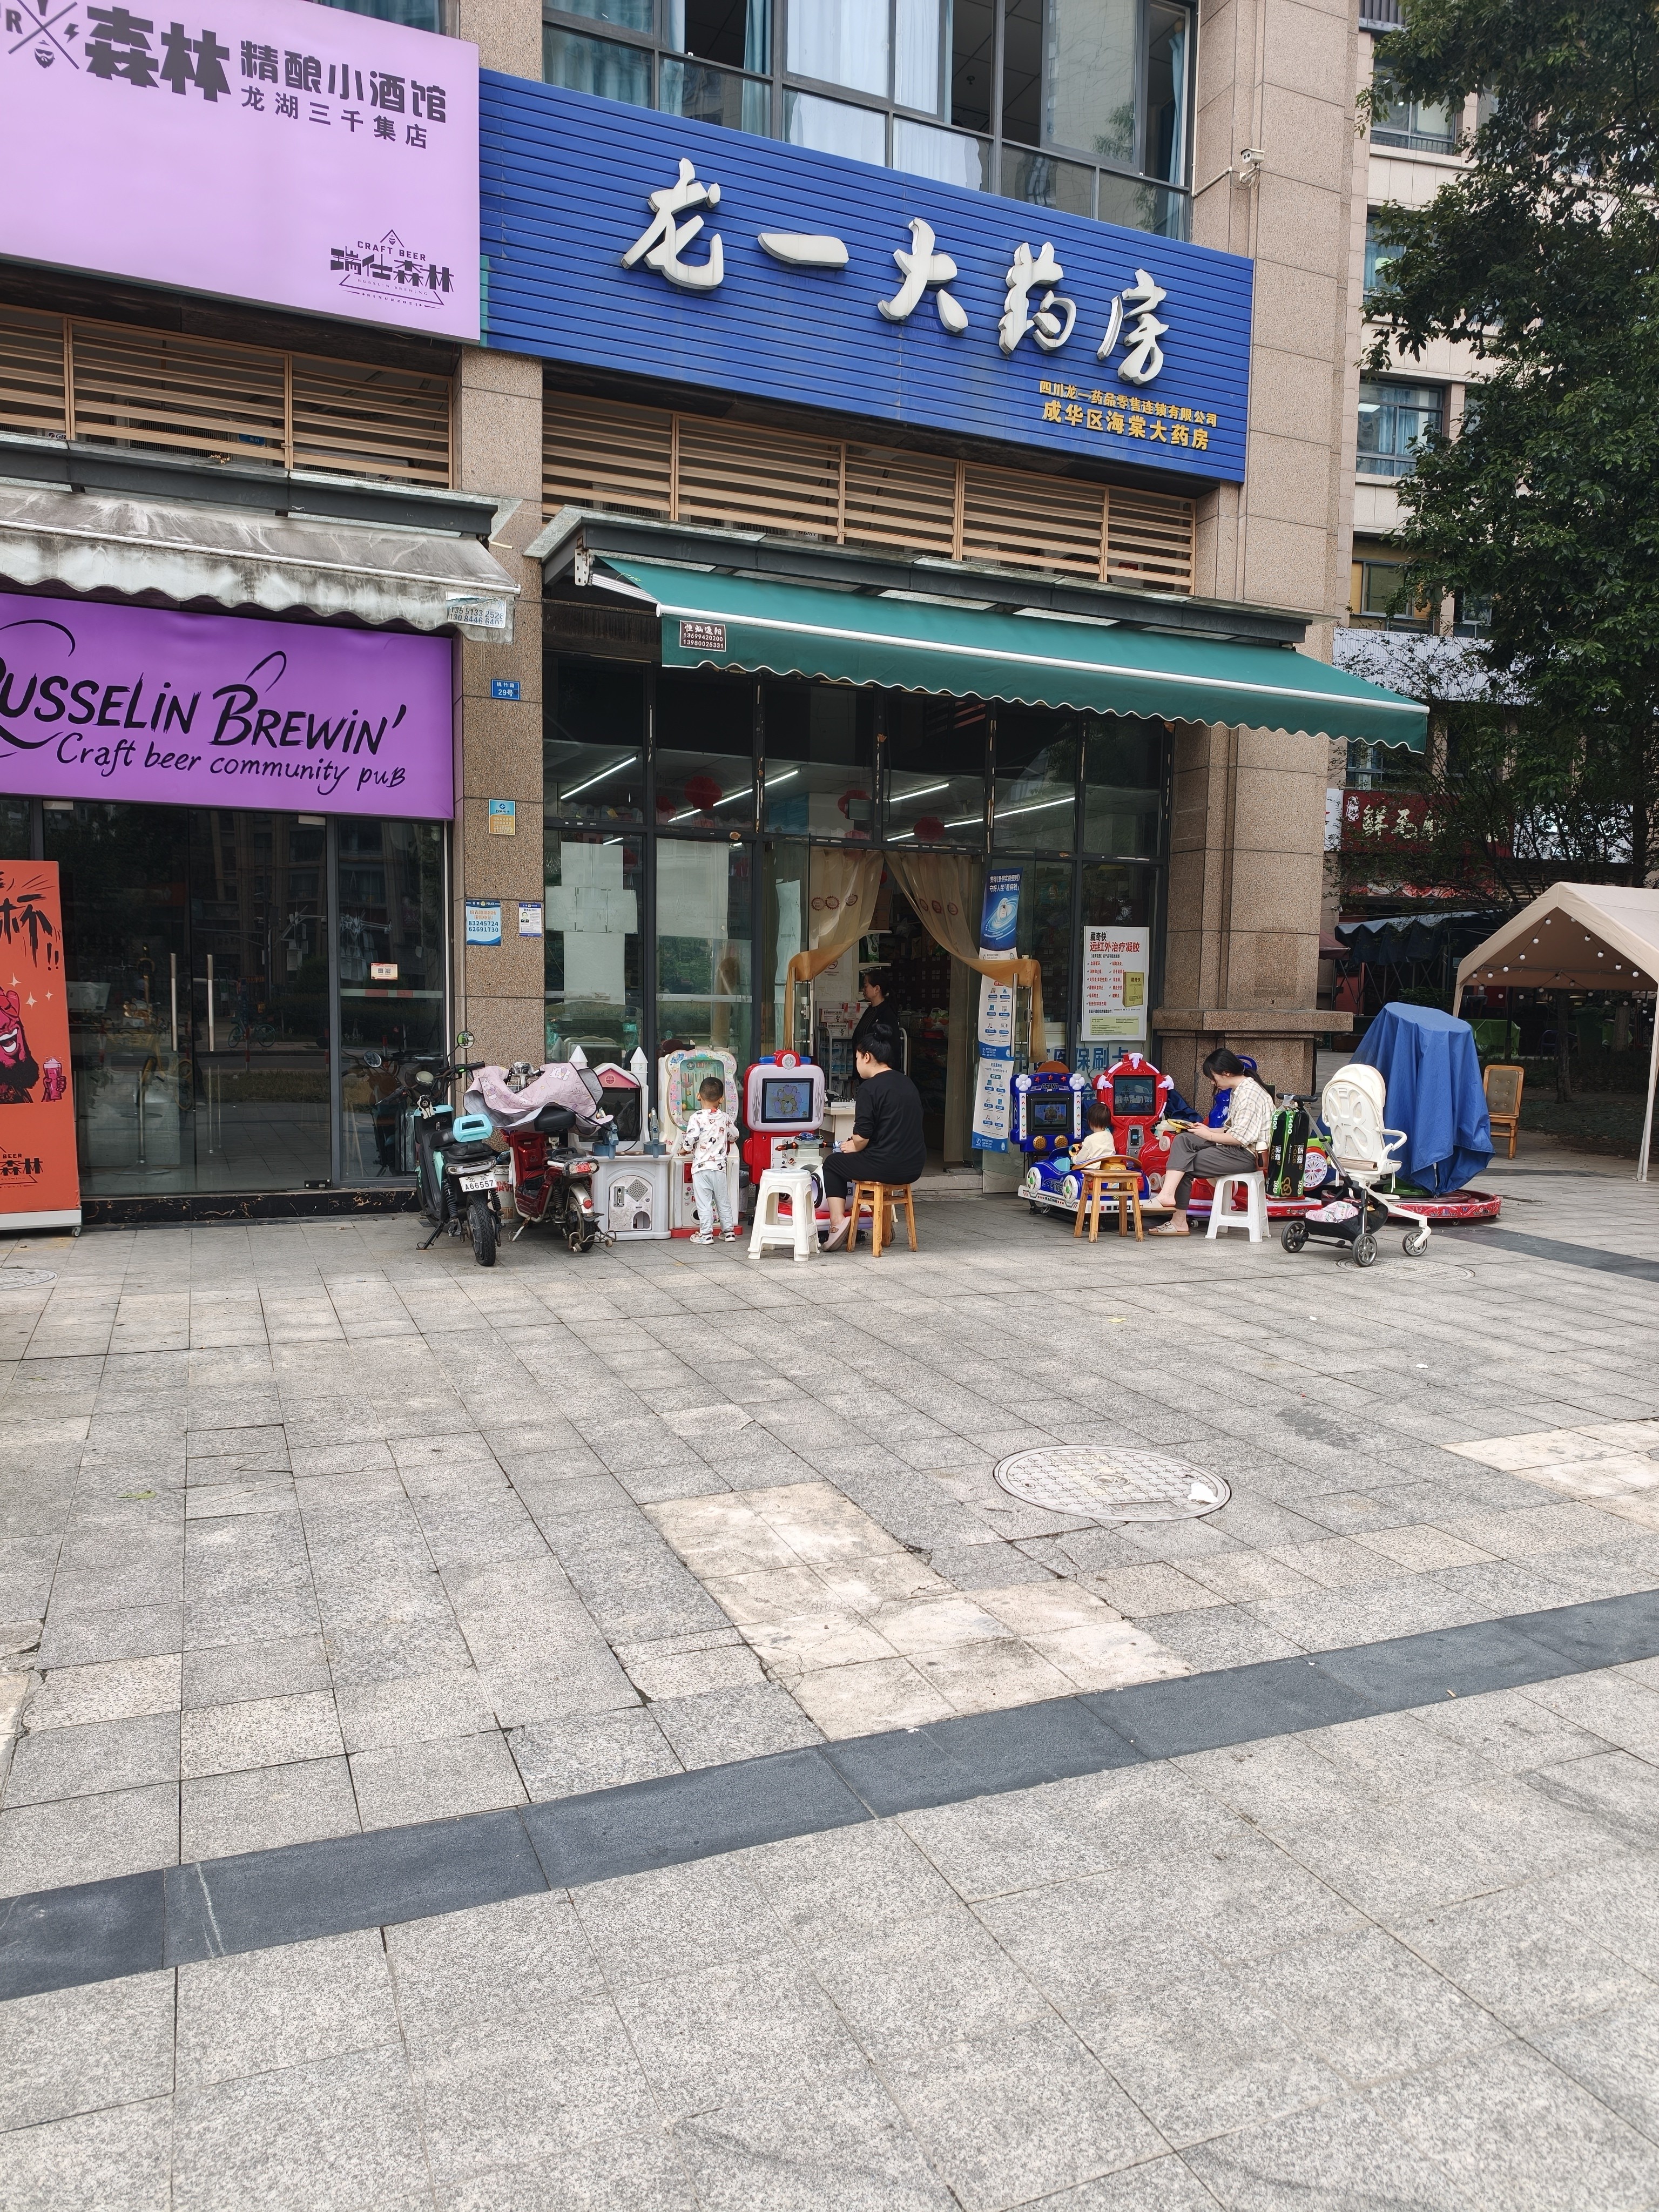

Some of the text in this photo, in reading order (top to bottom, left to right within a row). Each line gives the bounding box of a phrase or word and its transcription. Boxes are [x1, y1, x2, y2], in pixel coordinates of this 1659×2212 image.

[85, 5, 446, 123] 森林 精酿小酒馆
[241, 86, 427, 149] 龙湖三千集店
[330, 246, 454, 293] 瑞仕森林
[358, 241, 426, 261] CRAFT BEER
[621, 158, 1169, 385] 龙一大药房
[1040, 380, 1217, 427] 四川龙一药品零售连锁有限公司
[1042, 400, 1209, 450] 成华区海棠大药房
[683, 633, 723, 642] 13699420200
[683, 639, 724, 648] 13980025331
[57, 732, 136, 777] Craft
[144, 738, 201, 770] beer
[210, 756, 350, 795] community
[1090, 942, 1140, 952] 远红外治疗凝胶
[465, 1179, 494, 1190] A66557
